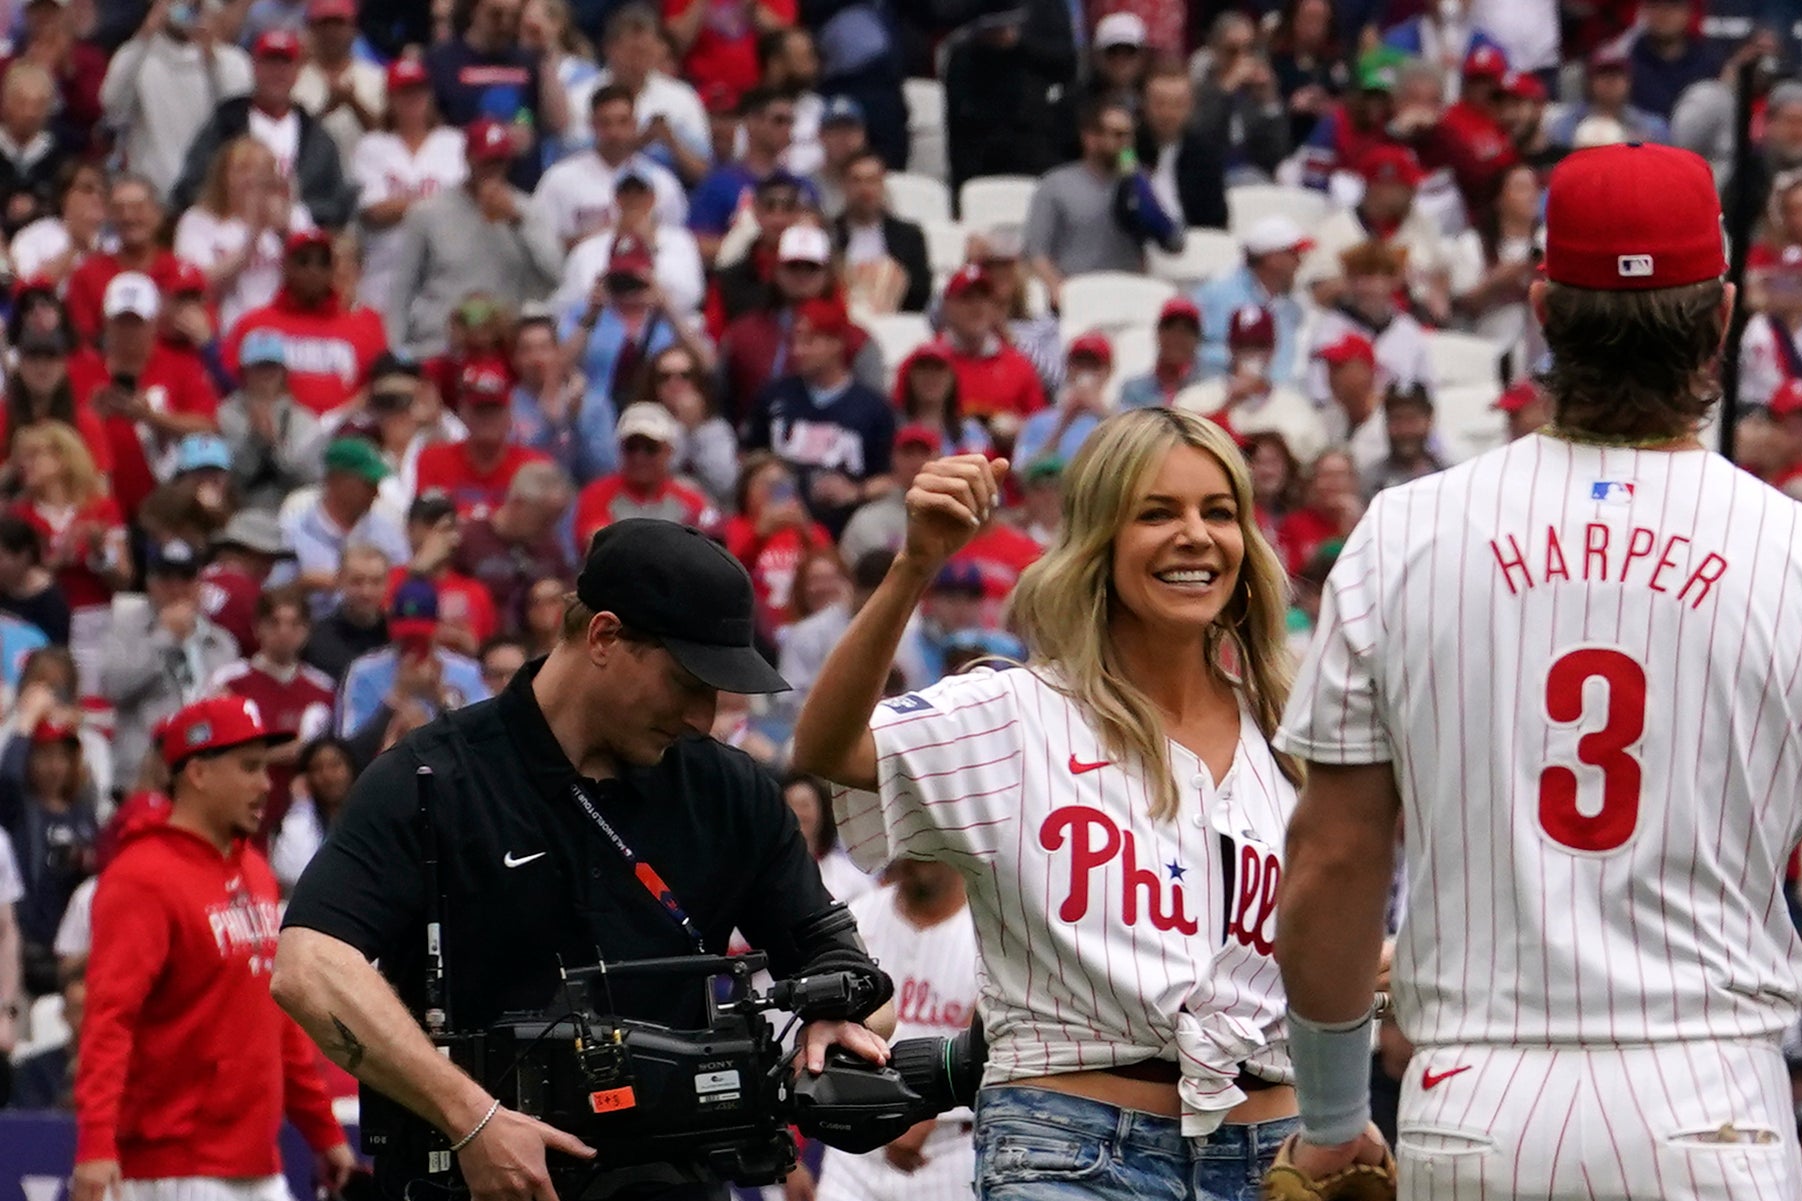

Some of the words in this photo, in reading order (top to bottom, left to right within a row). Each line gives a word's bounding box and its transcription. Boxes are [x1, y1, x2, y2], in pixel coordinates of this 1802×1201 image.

[1490, 523, 1727, 609] HARPER
[1538, 647, 1646, 852] 3
[698, 1060, 734, 1070] SONY
[819, 1121, 852, 1131] Canon
